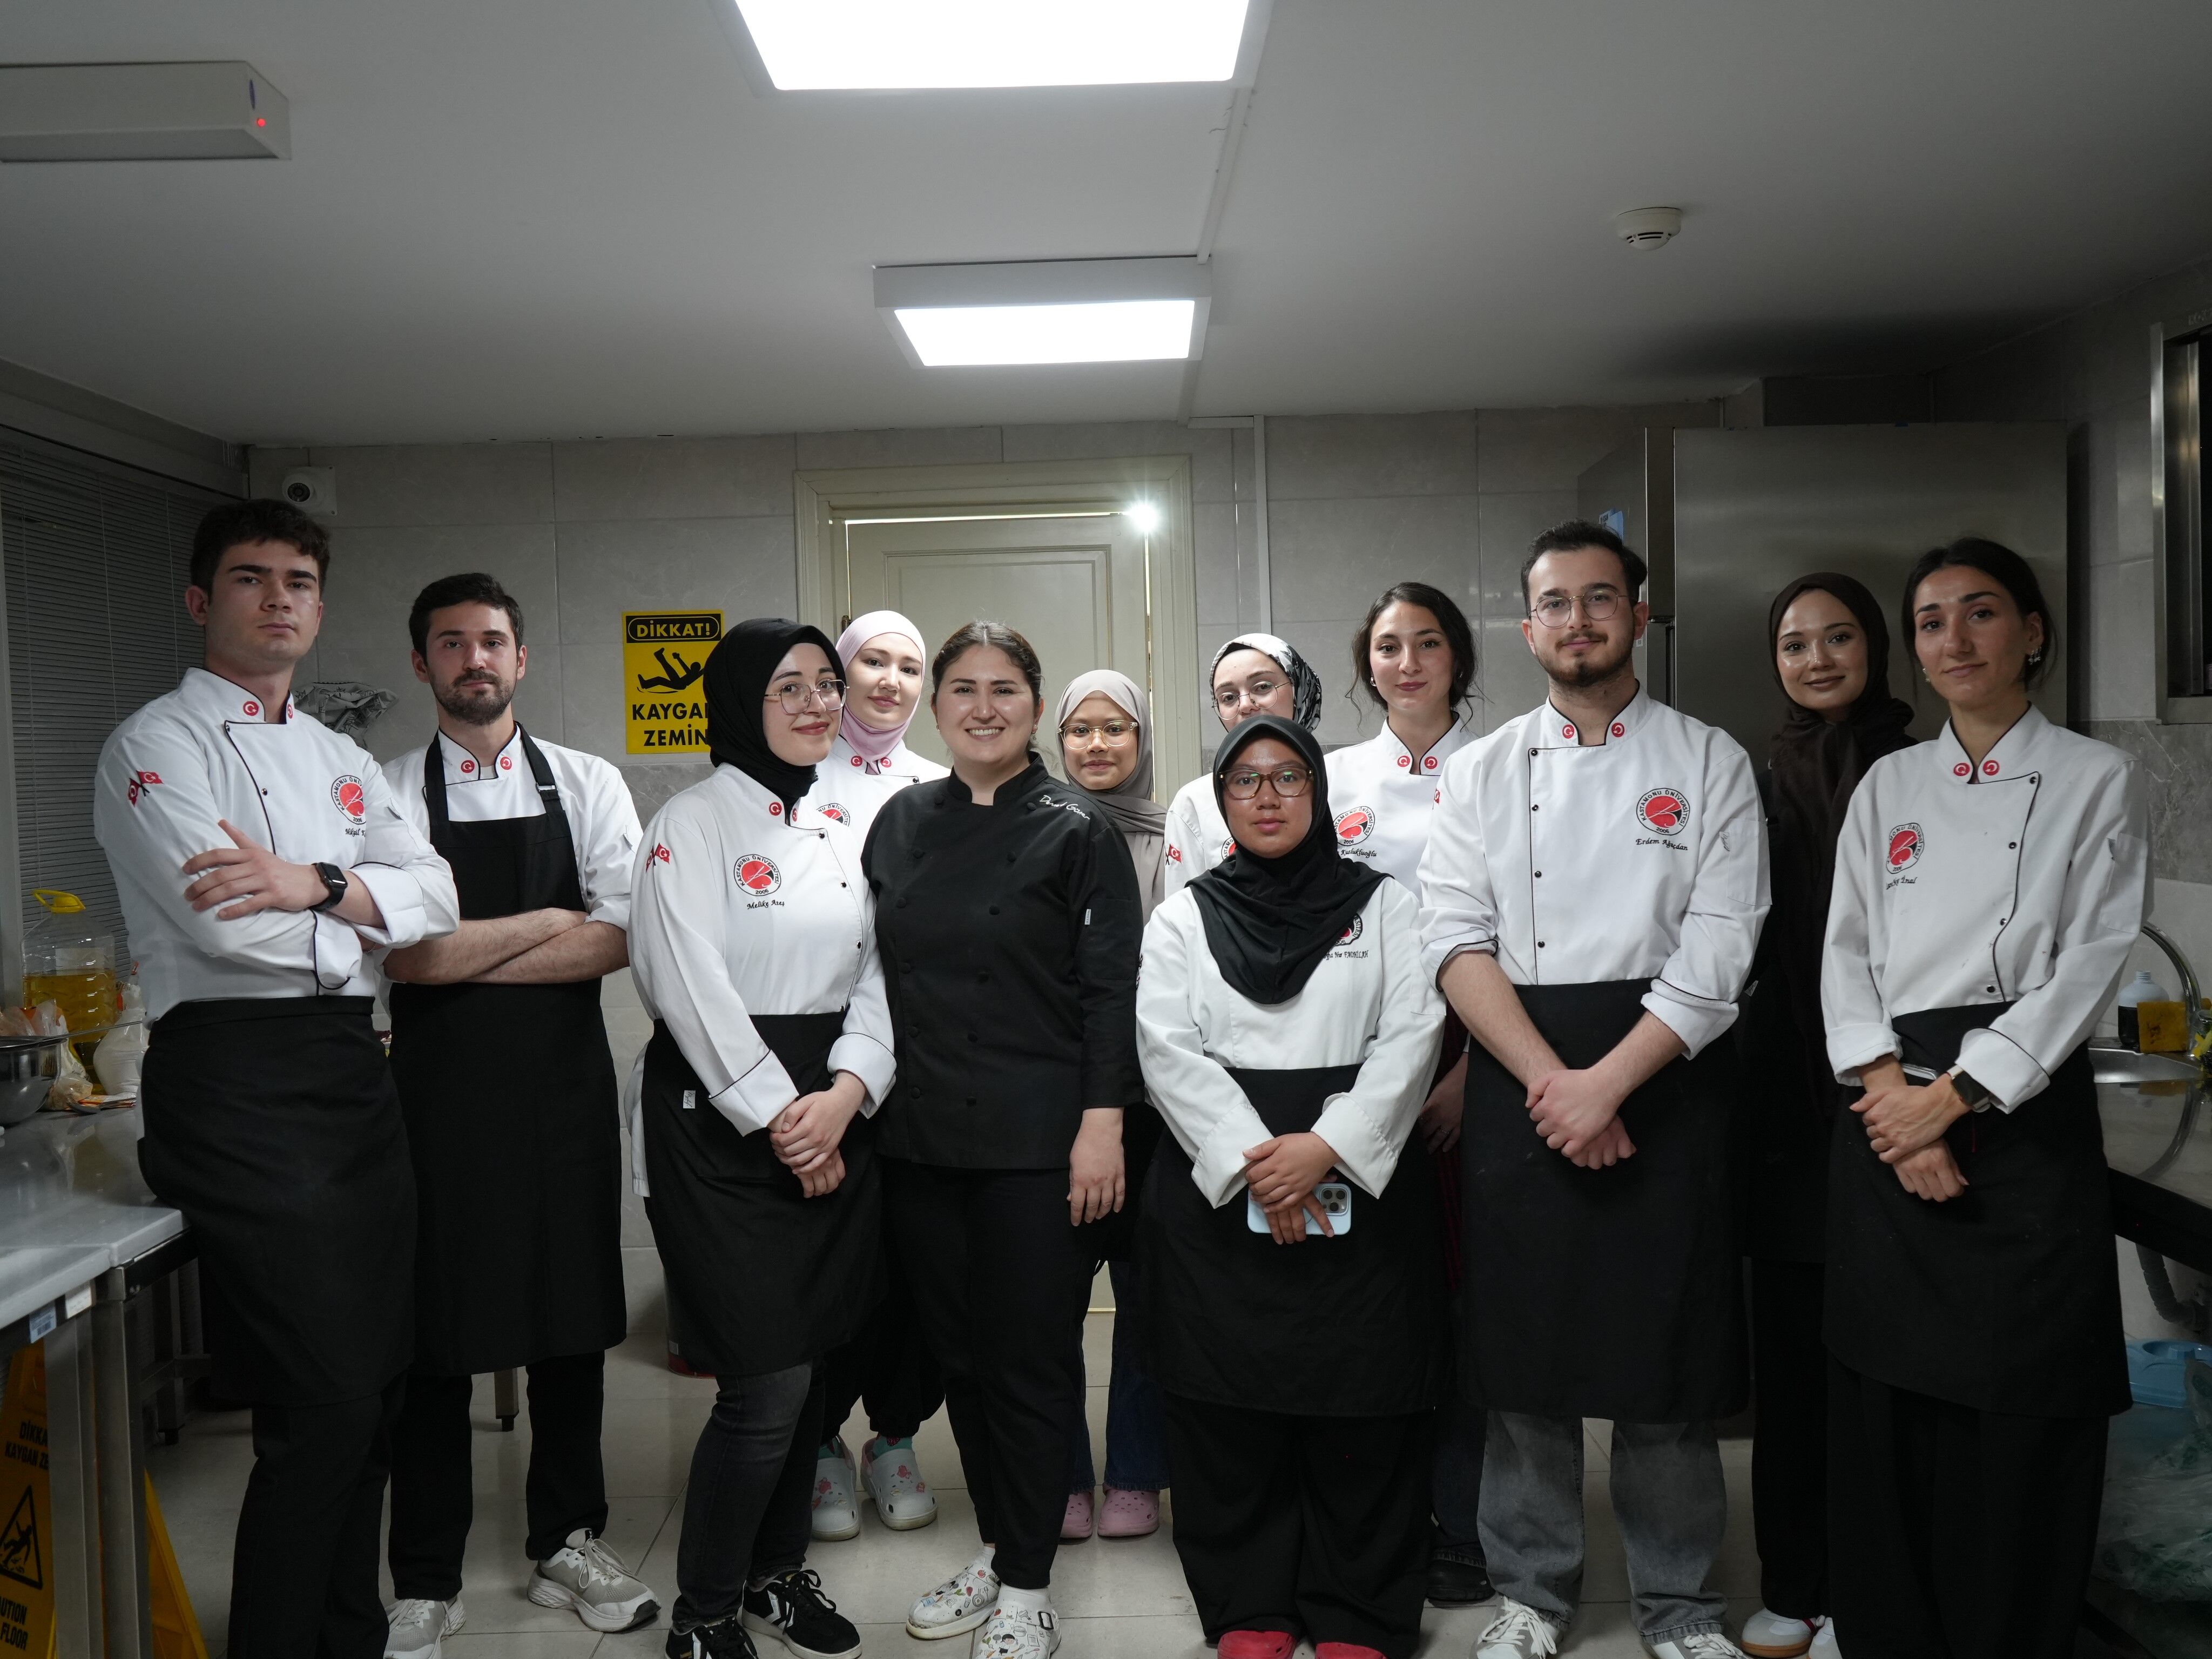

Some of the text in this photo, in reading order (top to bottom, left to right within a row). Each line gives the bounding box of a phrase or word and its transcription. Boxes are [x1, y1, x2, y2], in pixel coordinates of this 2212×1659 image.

[637, 621, 710, 637] DİKKAT!
[632, 703, 708, 720] KAYGA
[643, 724, 709, 746] ZEMİN
[1640, 791, 1662, 821] KASTAMONU
[736, 857, 750, 887] KASTAMONU
[0, 1596, 27, 1625] UTION
